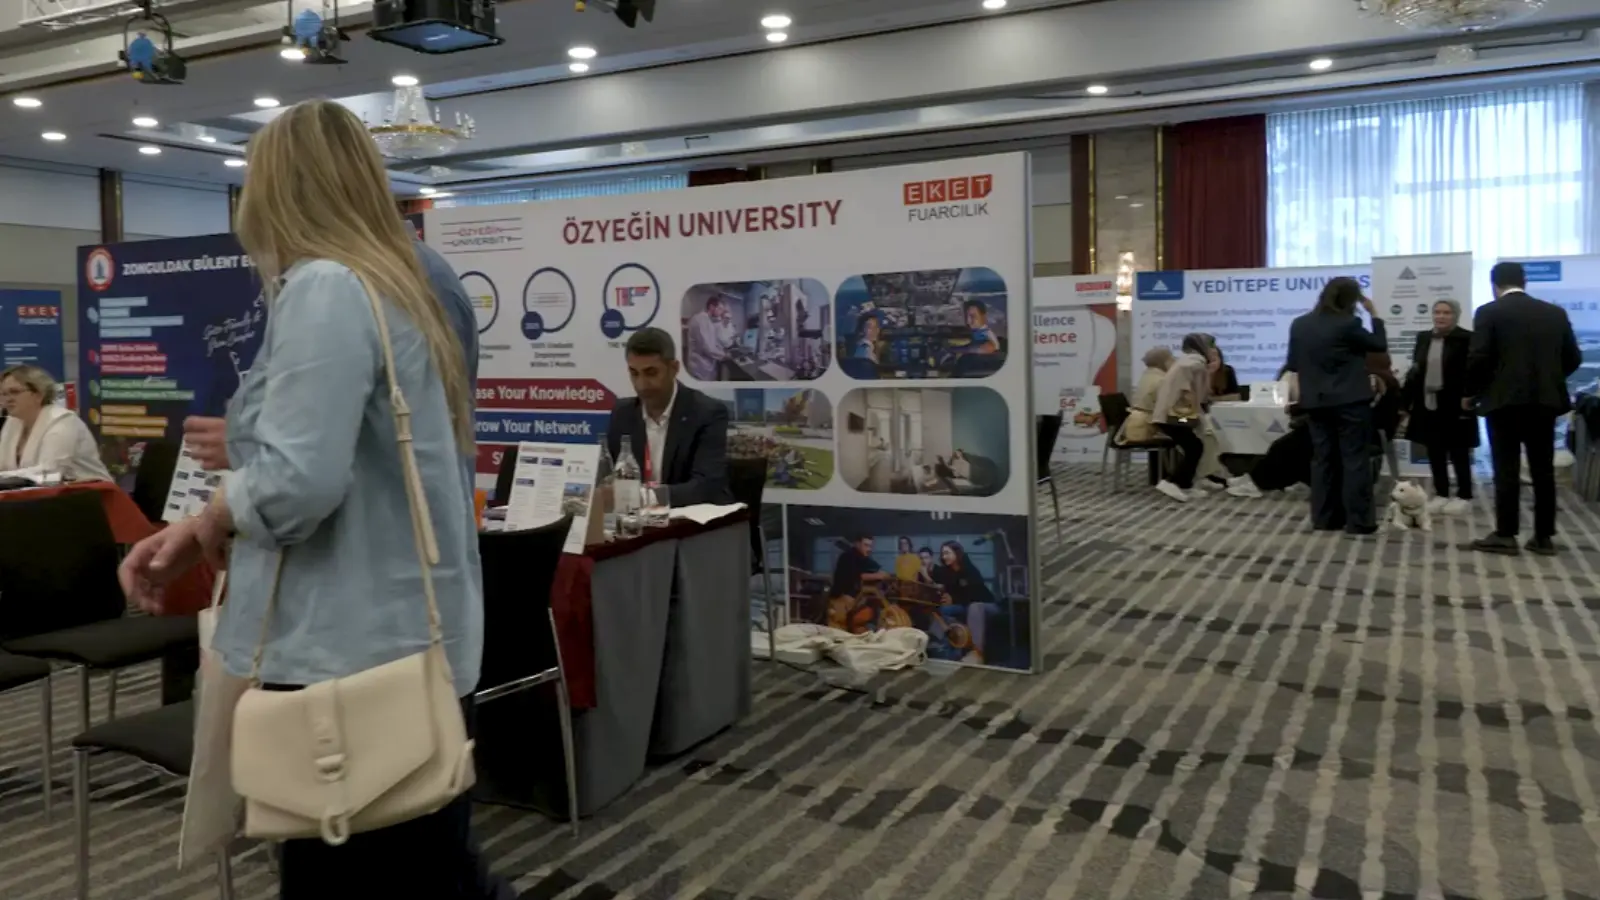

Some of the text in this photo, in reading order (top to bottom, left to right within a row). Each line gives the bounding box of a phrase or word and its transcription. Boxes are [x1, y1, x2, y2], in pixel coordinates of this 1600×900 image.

[907, 177, 991, 203] EKET
[563, 199, 843, 245] ÖZYEĞİN UNIVERSITY
[908, 203, 989, 222] FUARCILIK
[122, 259, 191, 276] ZONGULDAK
[193, 254, 240, 271] BÜLENT
[1192, 275, 1279, 294] YEDİTEPE
[1033, 331, 1077, 344] ience
[497, 385, 527, 401] Your
[529, 385, 605, 403] Knowledge
[502, 418, 531, 434] Your
[534, 419, 592, 435] Network
